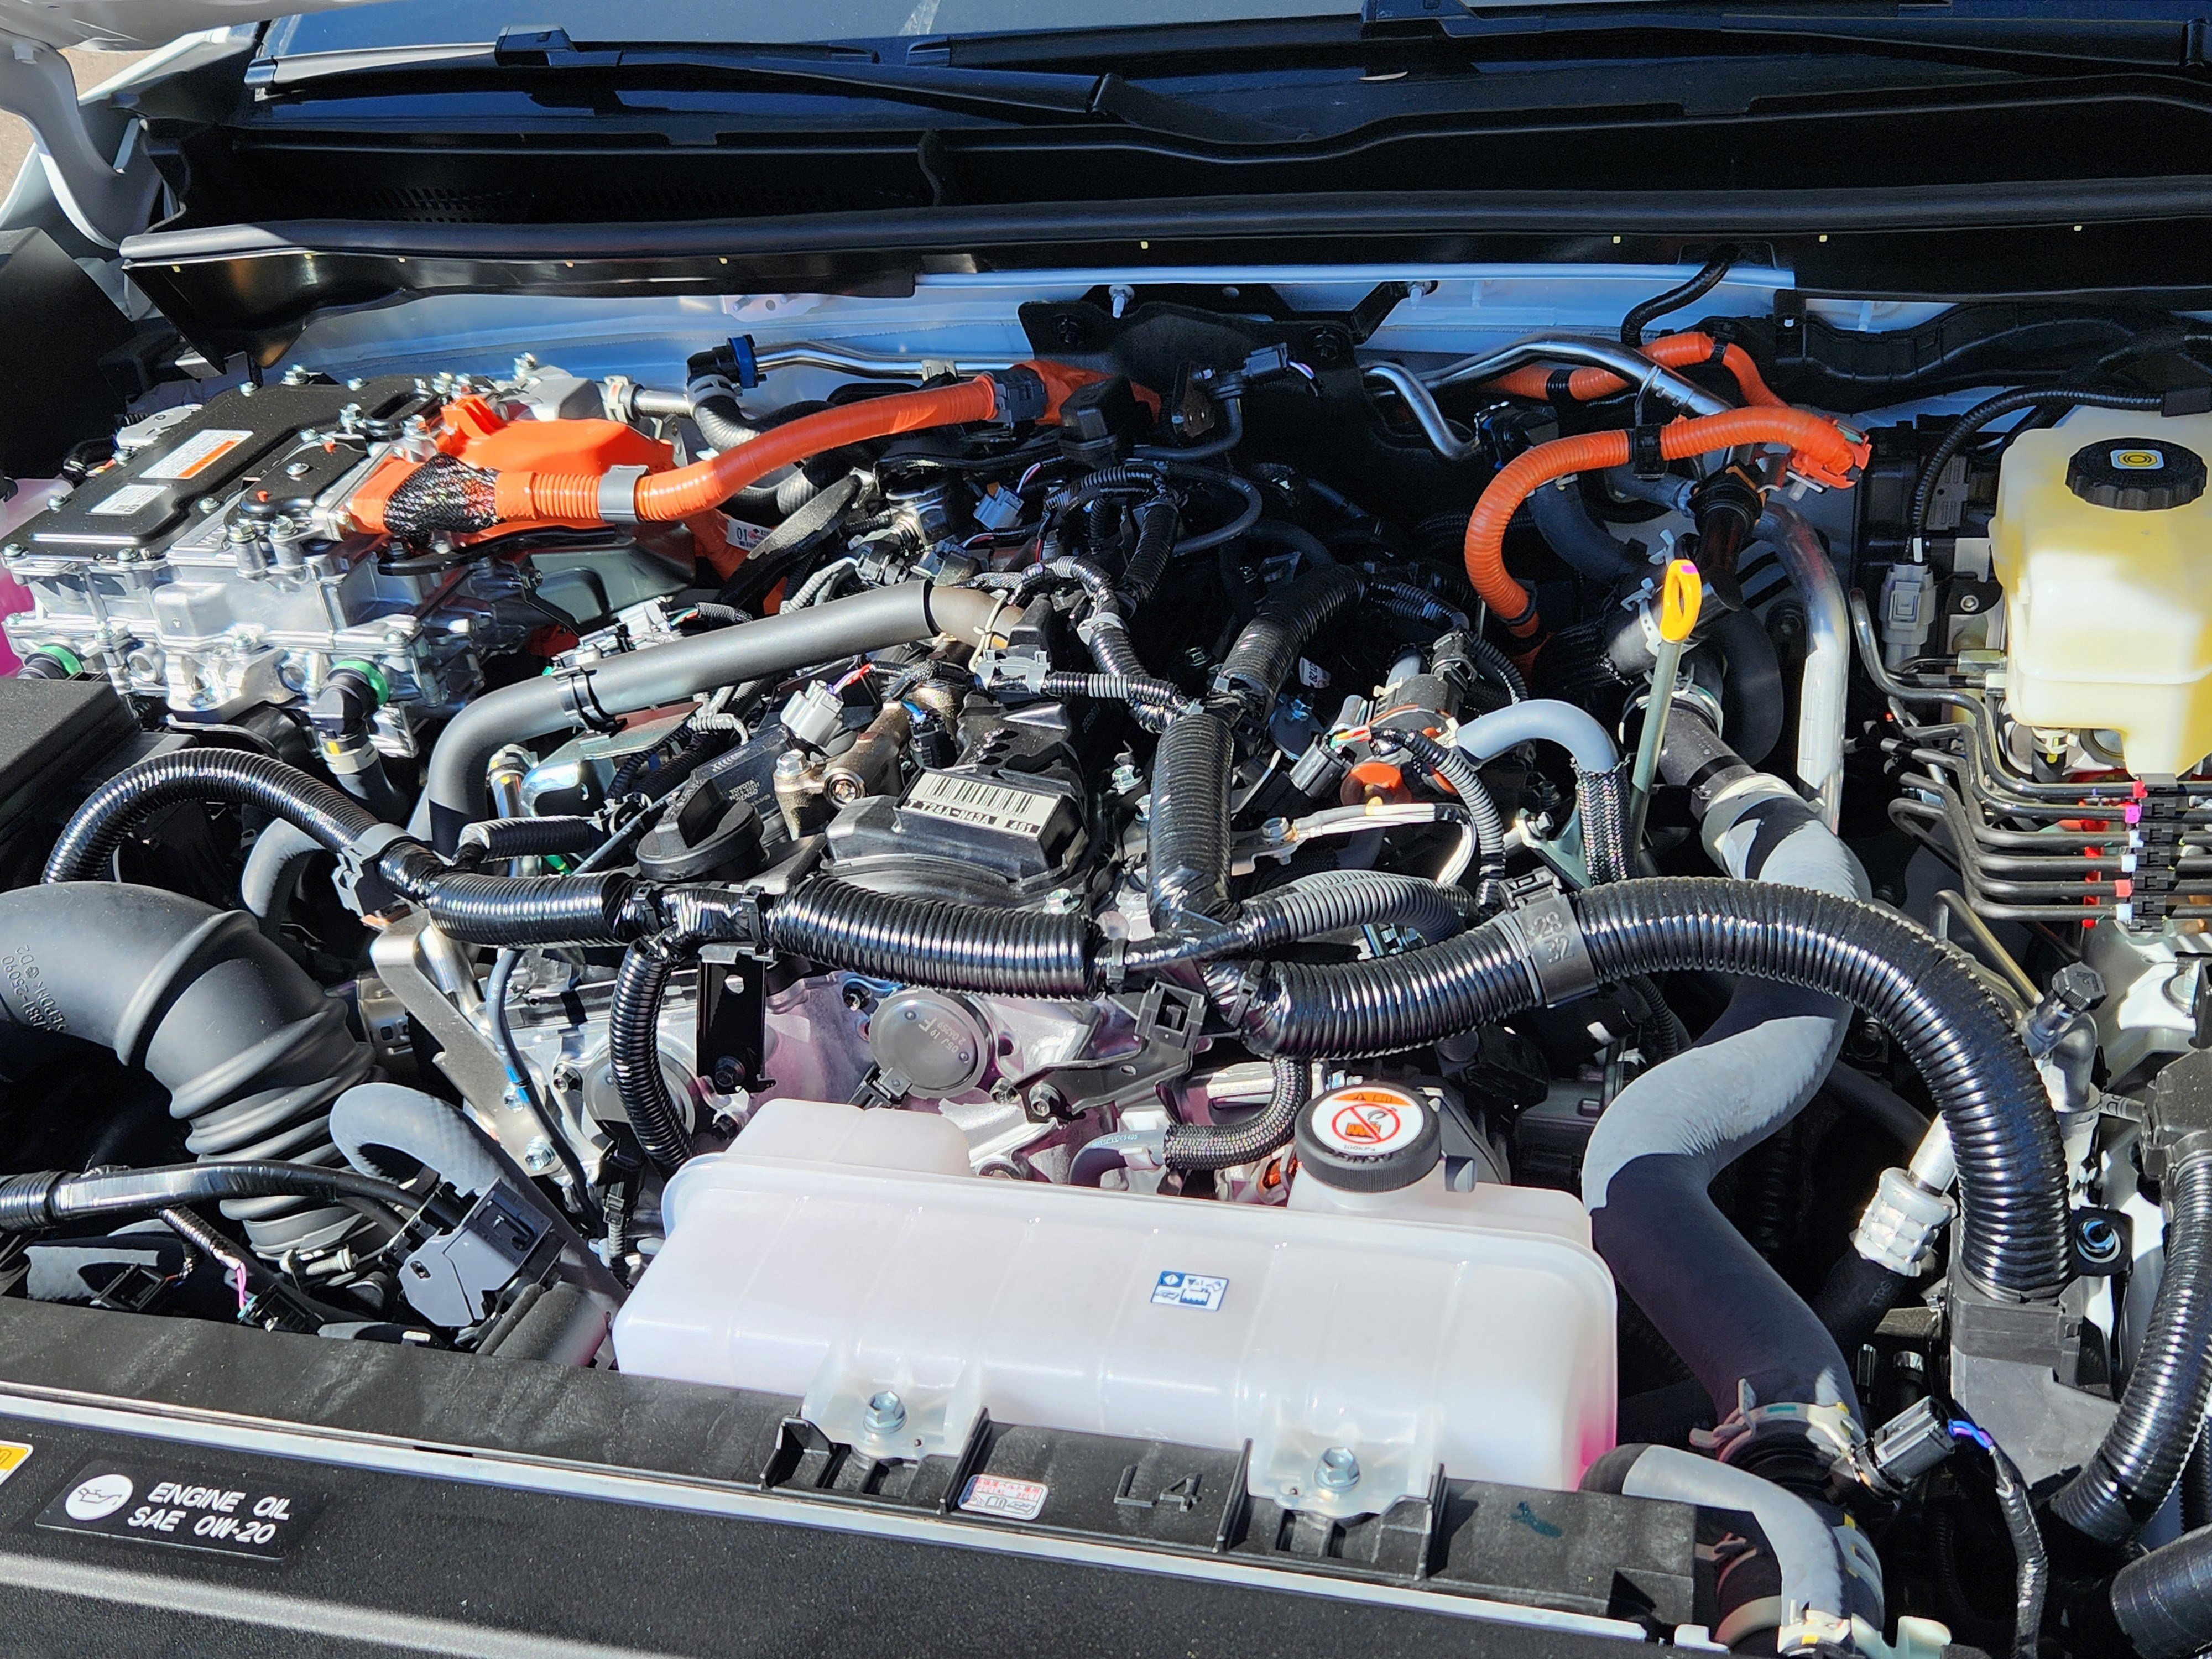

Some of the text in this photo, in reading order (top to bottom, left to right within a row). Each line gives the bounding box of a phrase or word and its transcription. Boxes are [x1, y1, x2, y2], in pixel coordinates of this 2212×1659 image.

[729, 780, 758, 795] TOYOTA
[919, 1017, 938, 1032] F
[147, 1481, 291, 1521] ENGINE OIL
[1113, 1464, 1203, 1513] L4
[127, 1506, 276, 1545] SAE 0W-20
